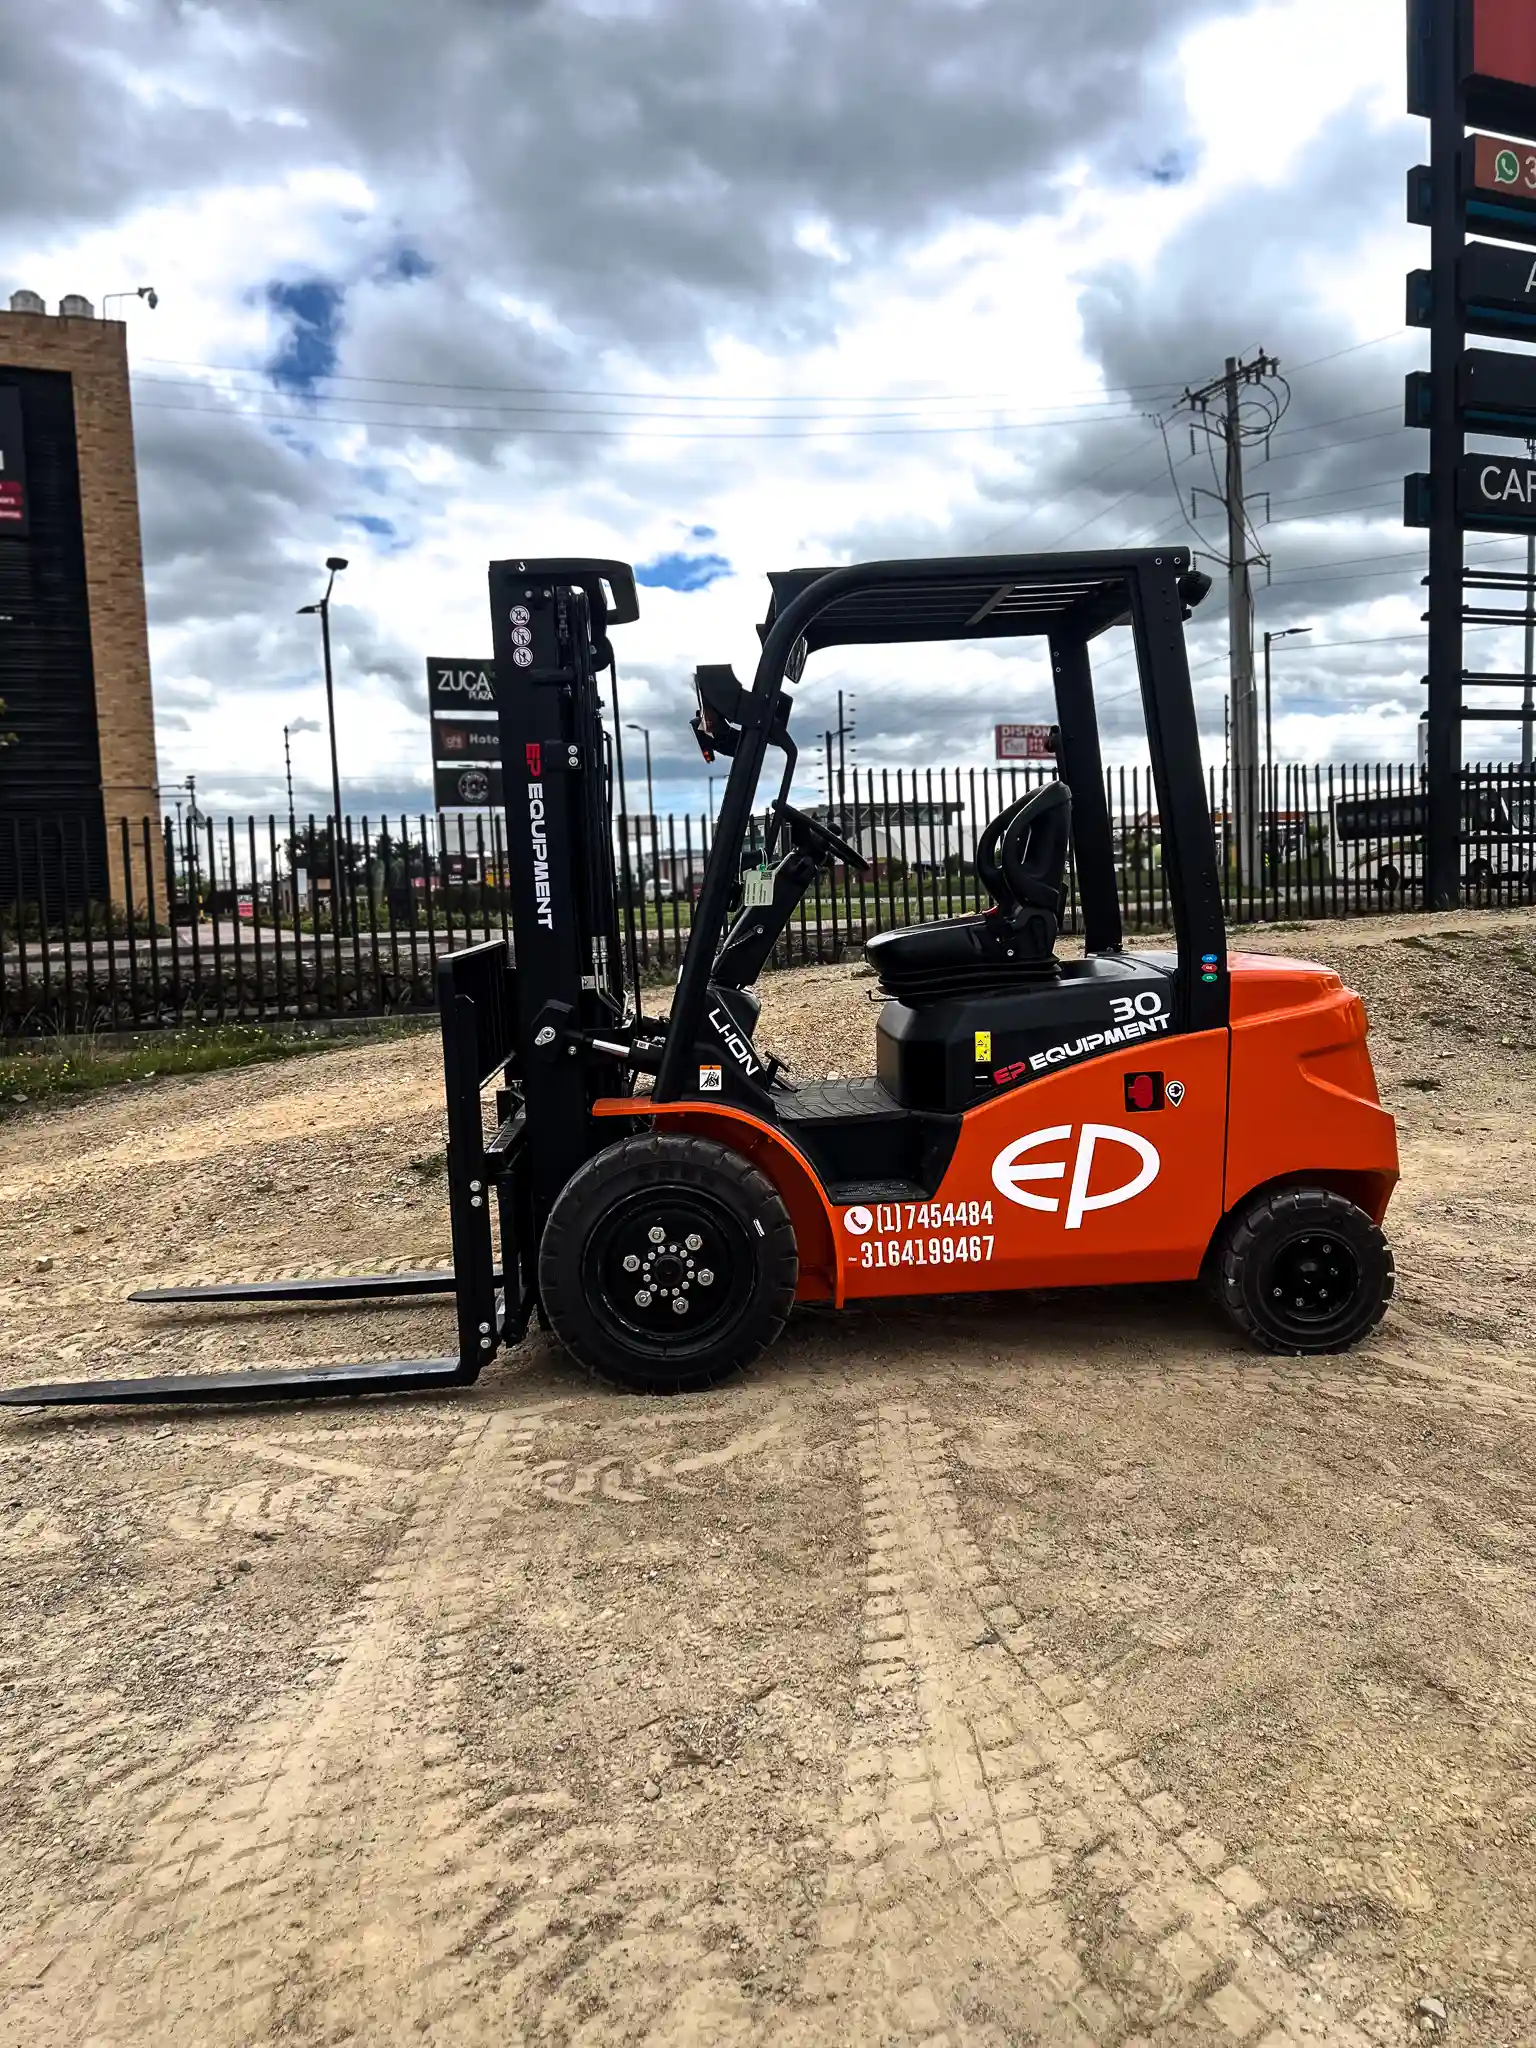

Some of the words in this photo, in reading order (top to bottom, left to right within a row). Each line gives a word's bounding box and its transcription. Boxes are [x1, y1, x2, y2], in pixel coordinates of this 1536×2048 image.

[525, 742, 542, 777] EP
[527, 782, 553, 931] EQUIPMENT
[1109, 991, 1162, 1023] 30
[993, 1061, 1026, 1085] EP
[1028, 1012, 1171, 1071] EQUIPMENT
[991, 1123, 1161, 1230] EP
